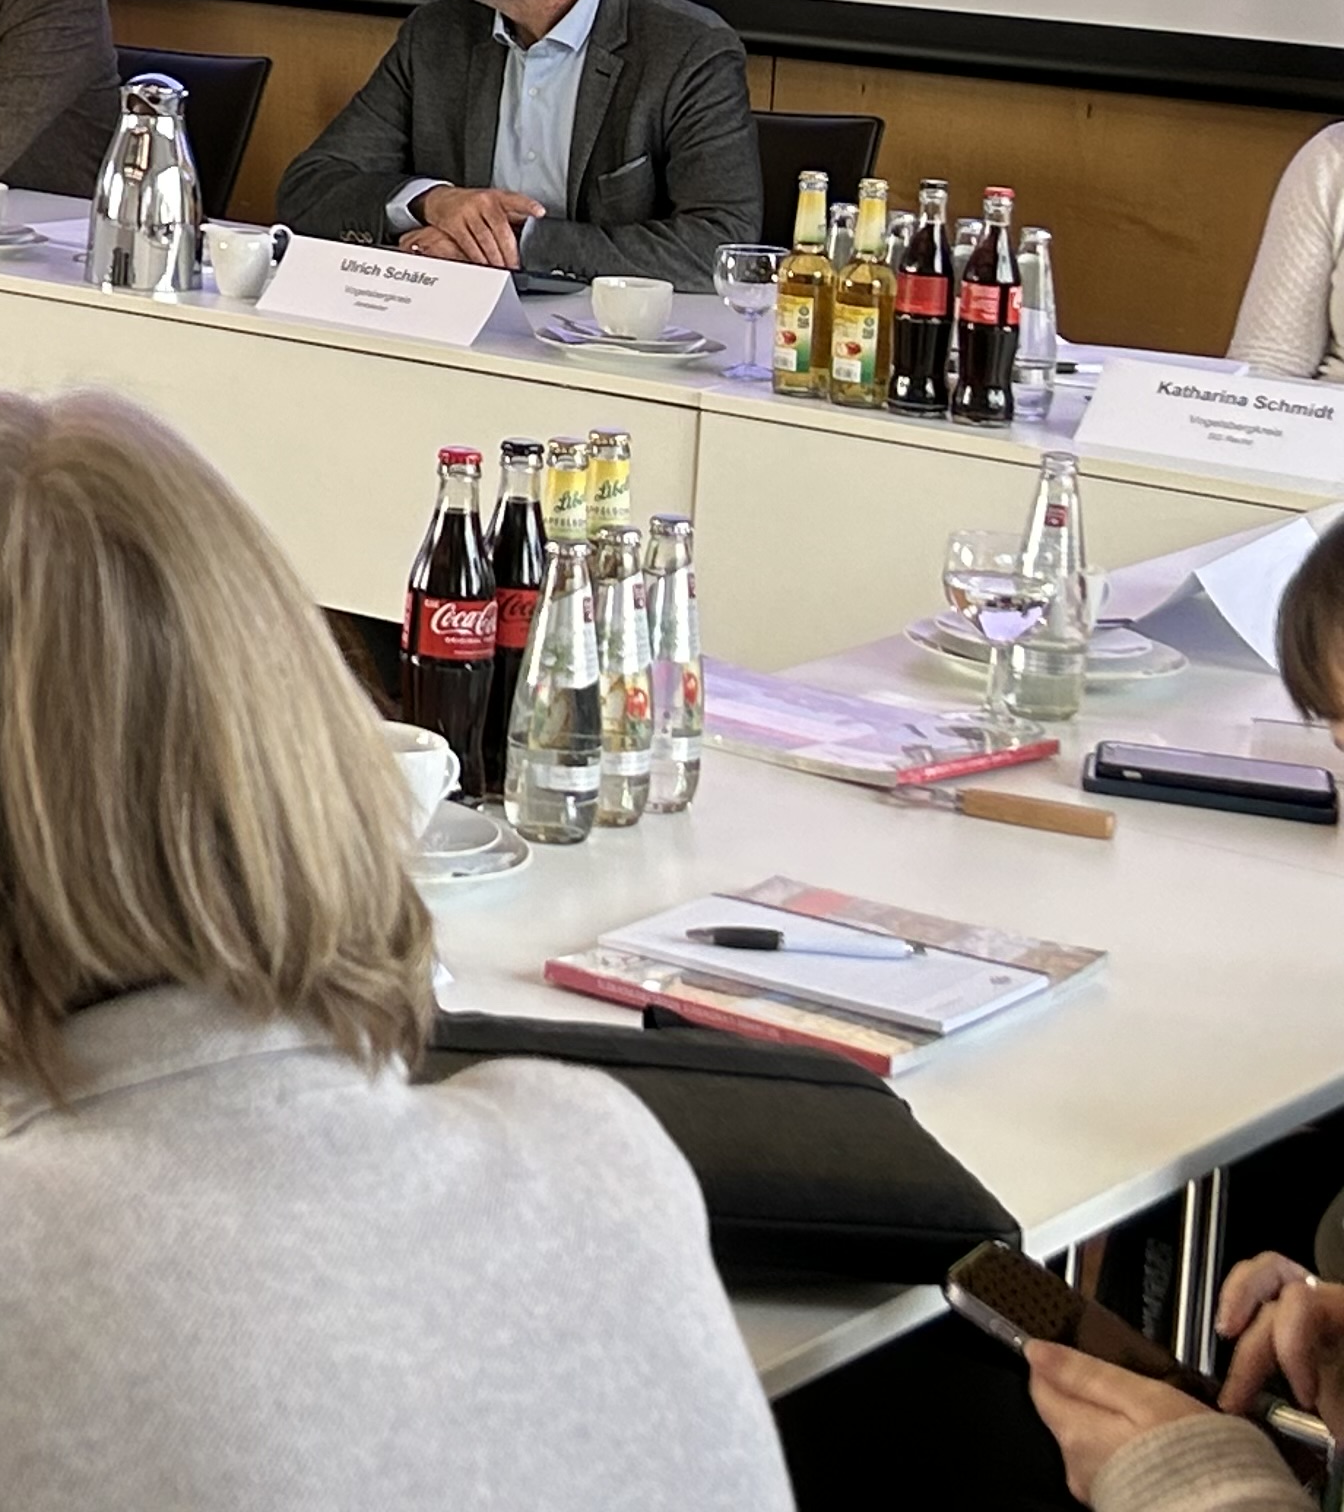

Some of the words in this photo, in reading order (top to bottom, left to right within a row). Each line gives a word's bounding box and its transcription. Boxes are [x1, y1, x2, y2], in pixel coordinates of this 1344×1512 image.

[340, 257, 380, 277] Ulrich
[383, 266, 439, 287] Schäfer
[1156, 380, 1249, 408] Katharina
[1252, 395, 1336, 421] Schmidt
